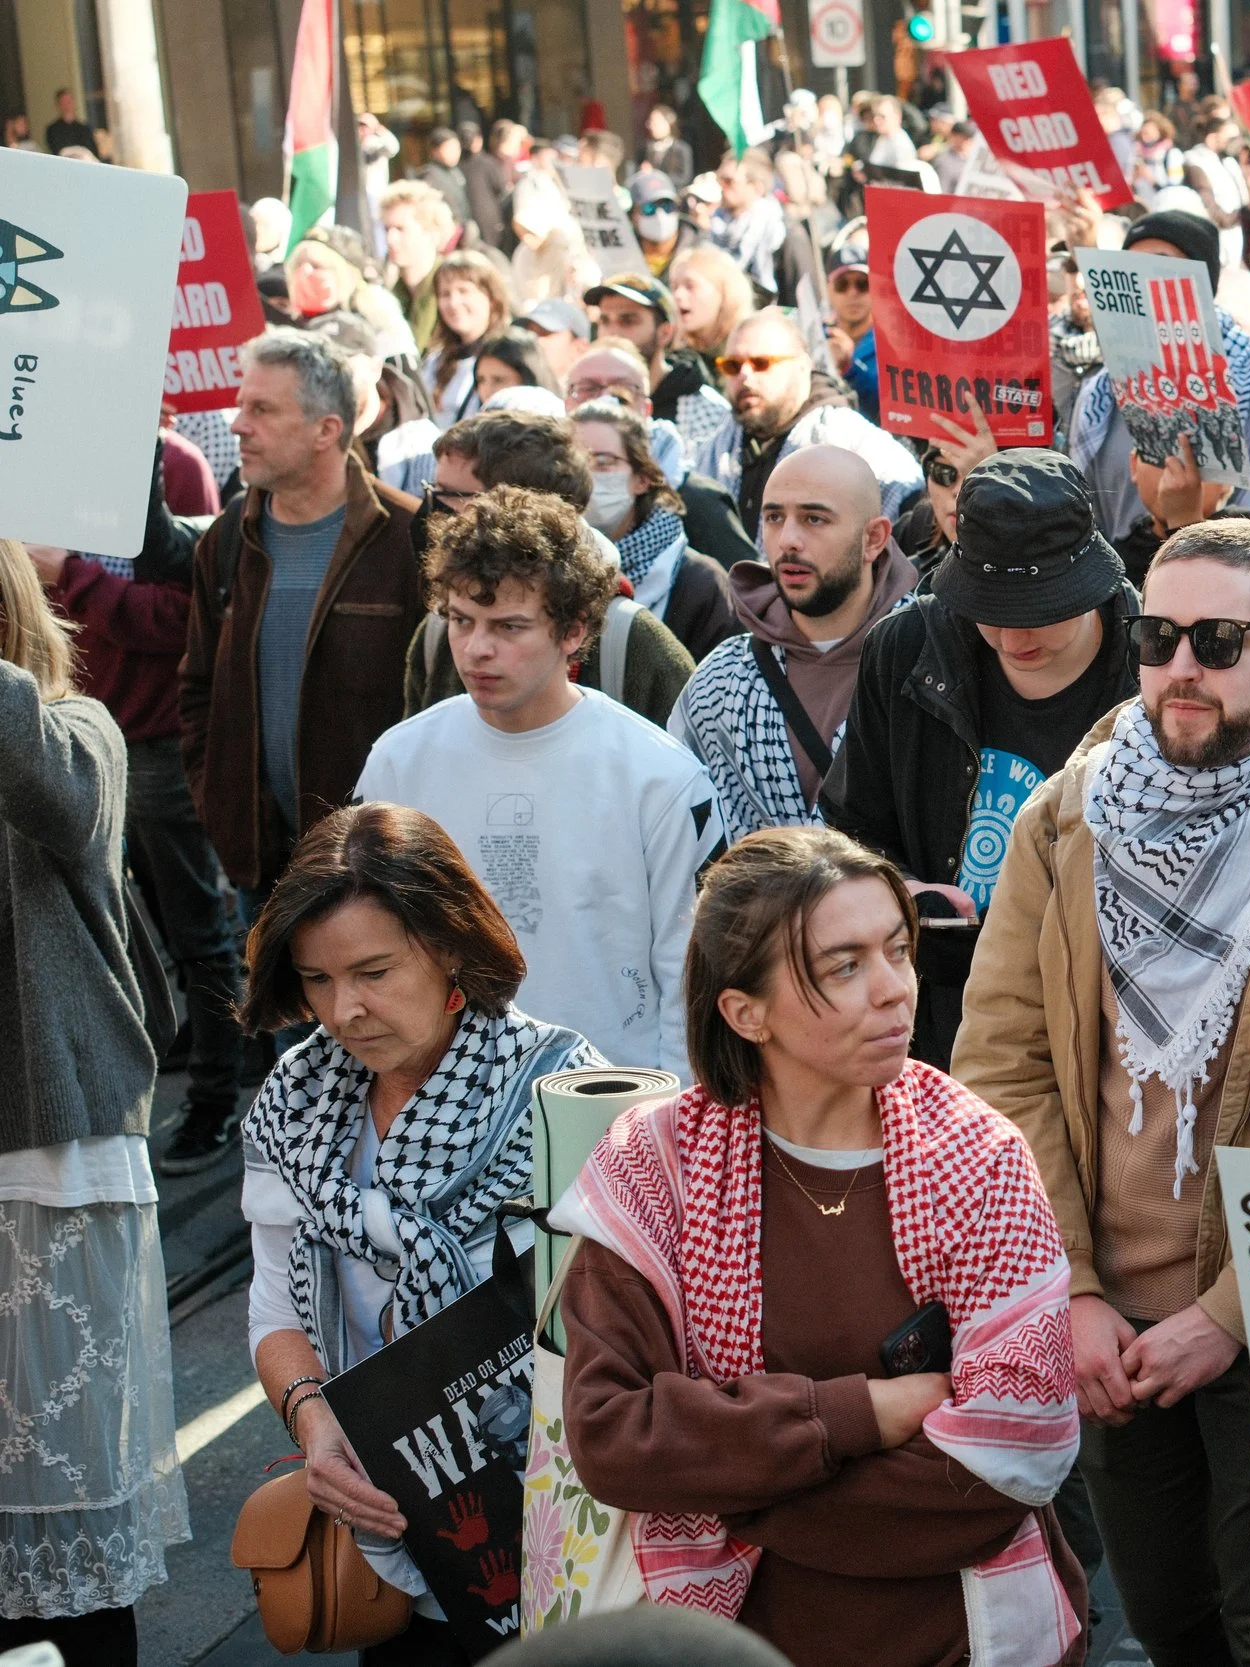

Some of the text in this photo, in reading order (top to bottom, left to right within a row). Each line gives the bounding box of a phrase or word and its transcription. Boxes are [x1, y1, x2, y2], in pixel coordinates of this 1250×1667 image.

[986, 60, 1048, 102] RED
[999, 112, 1079, 154] CARD
[1088, 268, 1141, 294] SAME
[171, 282, 232, 330] ARD
[1094, 291, 1146, 317] SAME
[164, 344, 244, 395] SRAE
[0, 354, 38, 441] Bluey
[996, 387, 1039, 404] STATE
[443, 1333, 532, 1403] DEAD OR ALIVE
